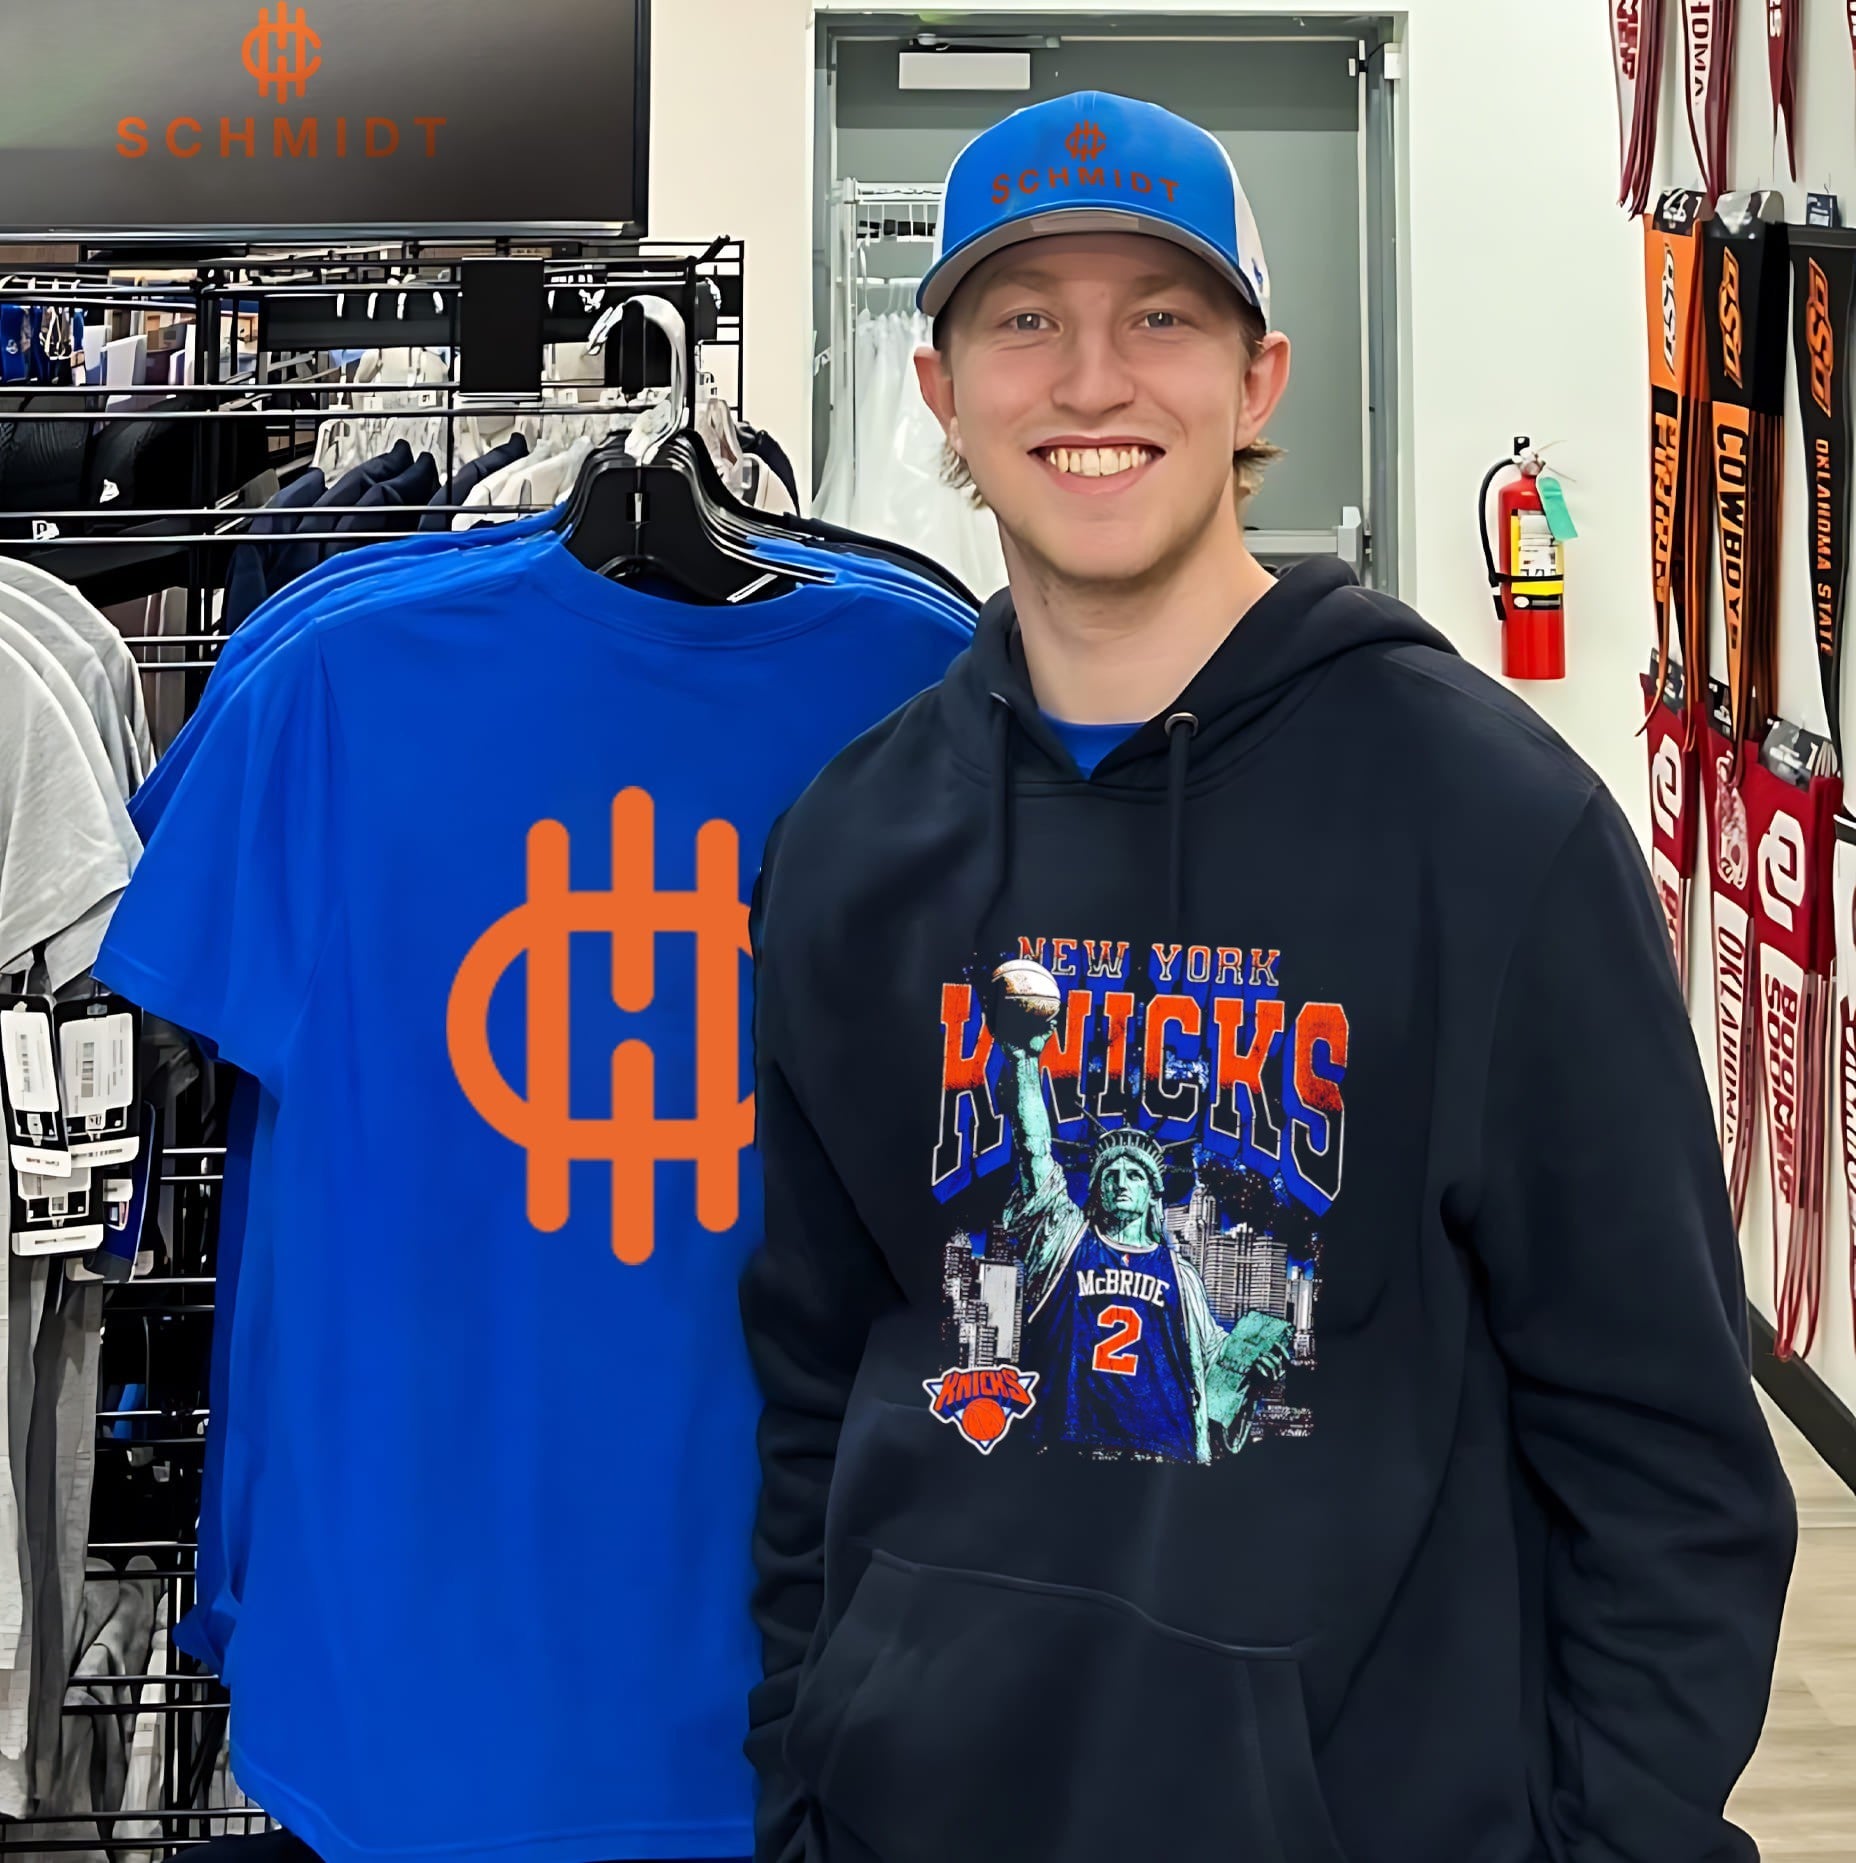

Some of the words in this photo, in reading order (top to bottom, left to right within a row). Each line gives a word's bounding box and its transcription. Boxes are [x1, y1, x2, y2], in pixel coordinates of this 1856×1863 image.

[115, 115, 448, 158] SCHMIDT
[991, 166, 1180, 205] SCHMIDT
[1815, 438, 1832, 570] OKLAHOMA
[1018, 936, 1129, 979] NEW
[1151, 943, 1281, 987] YORK
[931, 982, 1350, 1202] KNICKS
[1076, 1268, 1170, 1308] McBRIDE
[1092, 1304, 1142, 1376] 2
[933, 1368, 1032, 1412] KNICKS
